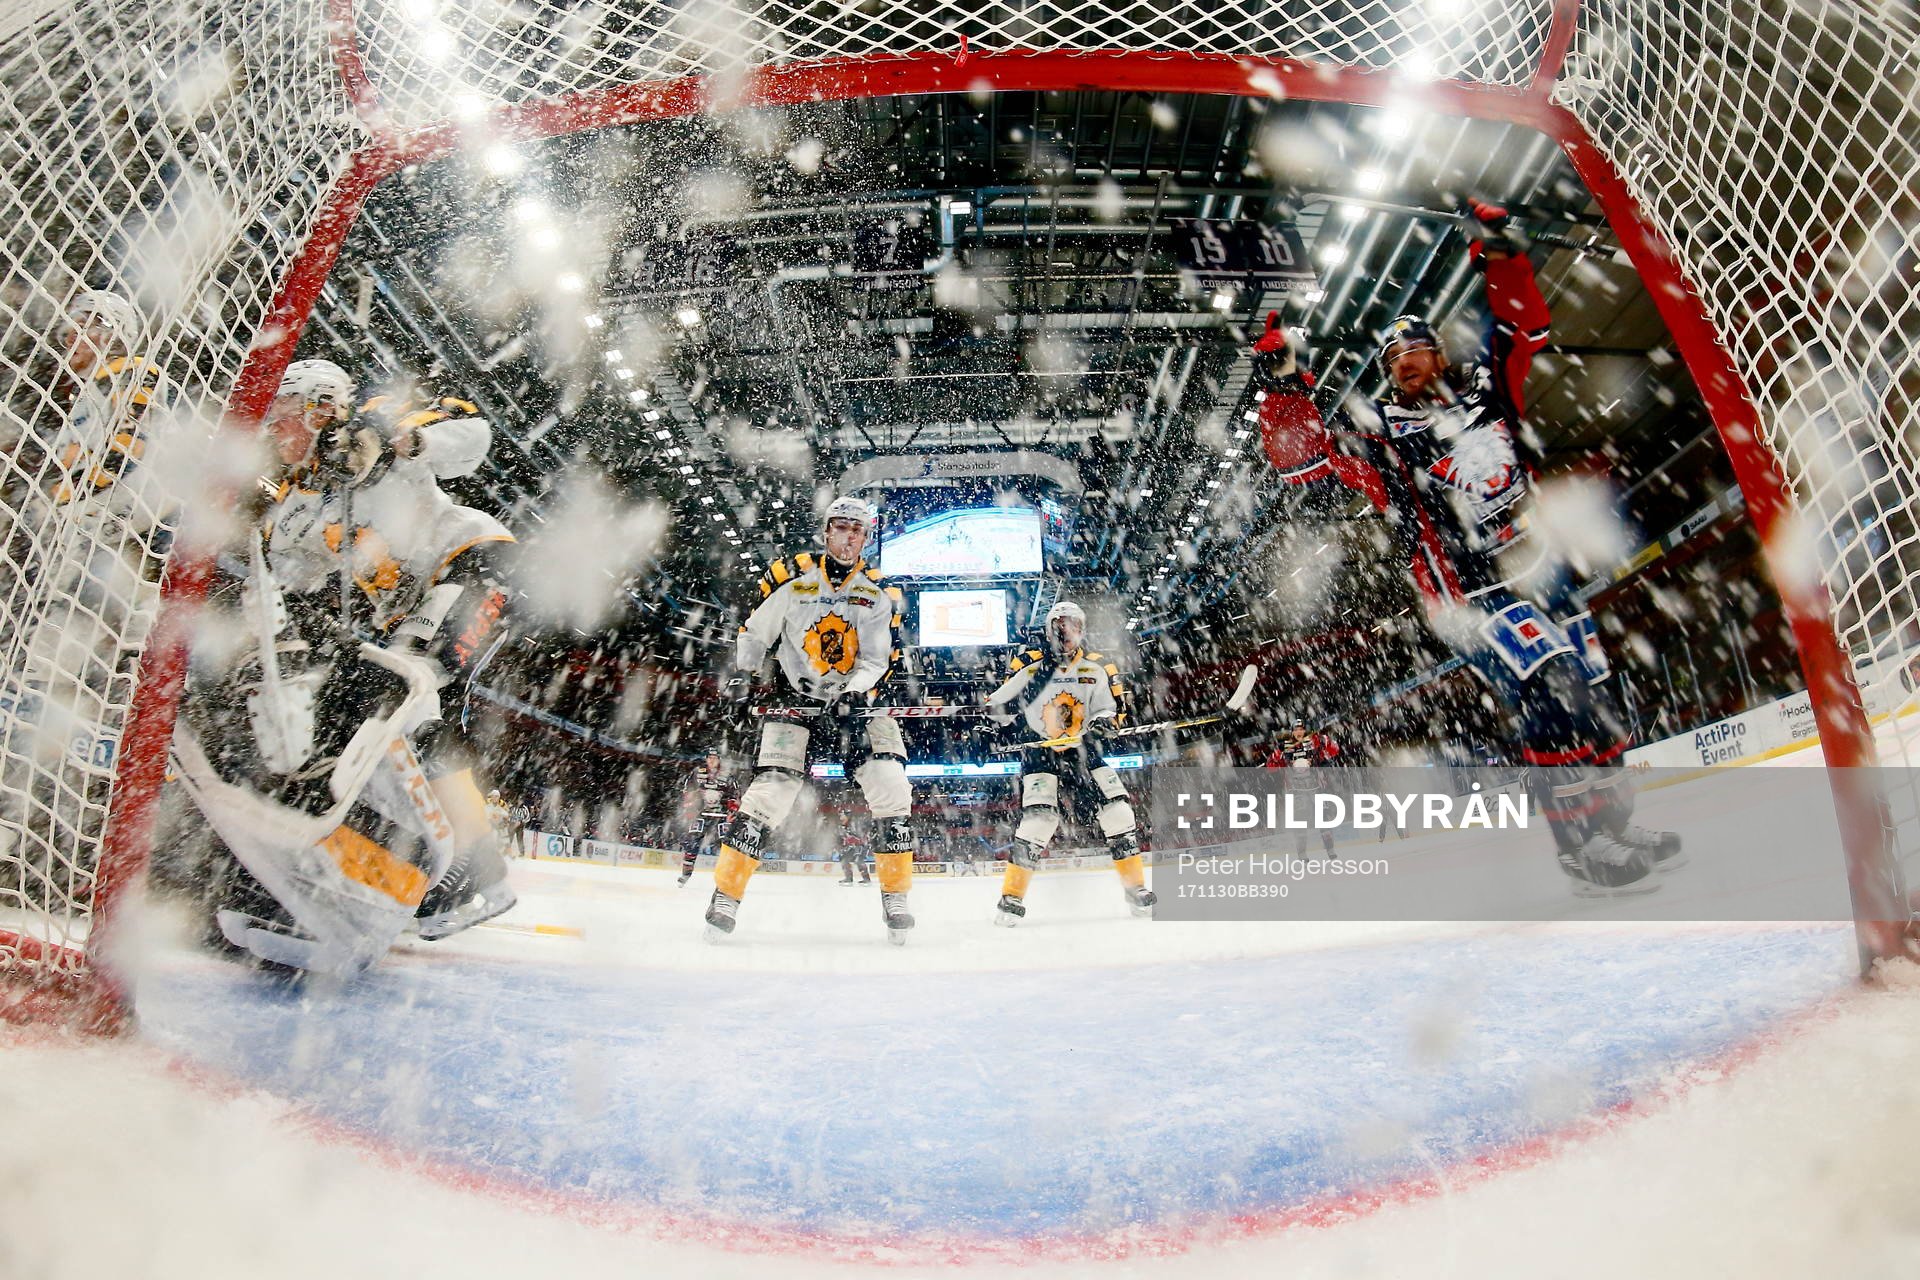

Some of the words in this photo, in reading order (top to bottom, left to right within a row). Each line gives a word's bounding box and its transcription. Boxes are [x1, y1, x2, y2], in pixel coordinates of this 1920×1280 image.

[1258, 238, 1295, 266] 10
[766, 707, 790, 715] CCM
[887, 706, 944, 717] CCM
[1118, 722, 1169, 737] CCM
[1695, 720, 1747, 750] ActiPro
[1702, 740, 1744, 767] Event
